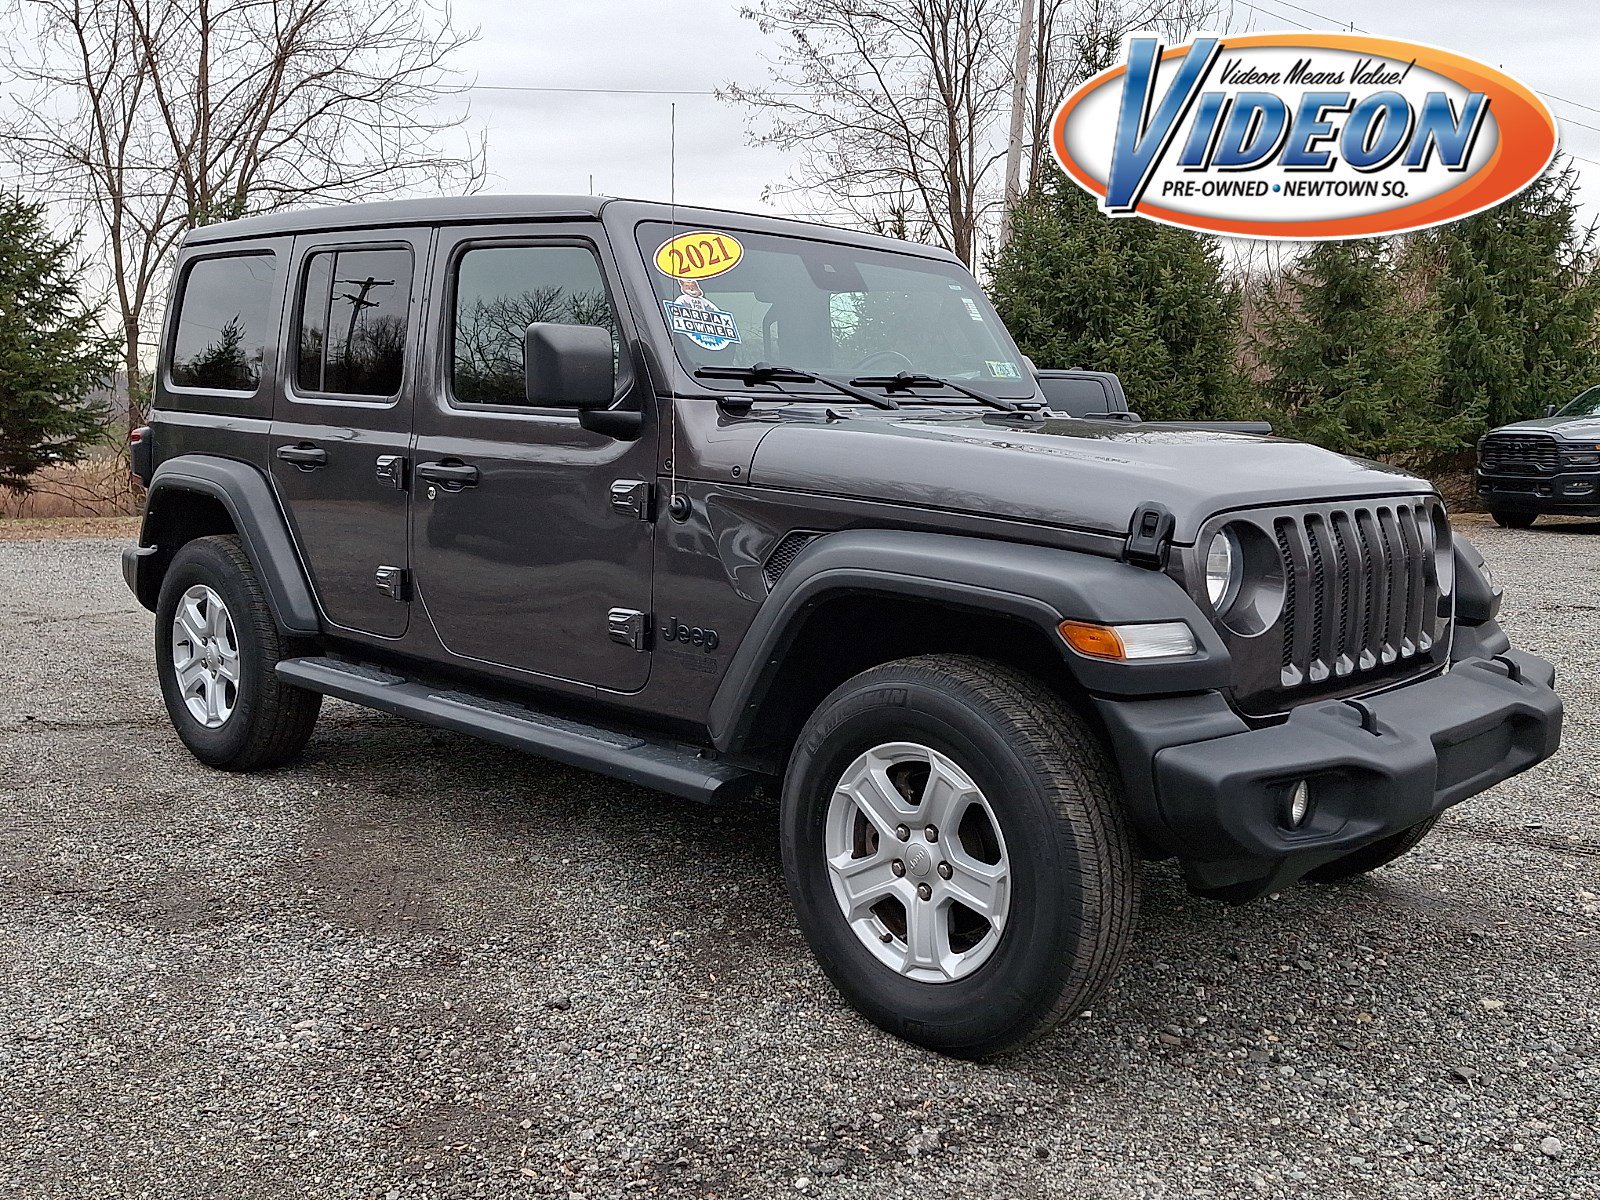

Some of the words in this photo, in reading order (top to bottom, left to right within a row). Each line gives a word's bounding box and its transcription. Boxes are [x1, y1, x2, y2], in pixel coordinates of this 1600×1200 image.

[668, 236, 733, 274] 2021
[670, 305, 732, 326] CARFAX
[661, 615, 719, 654] Jeep
